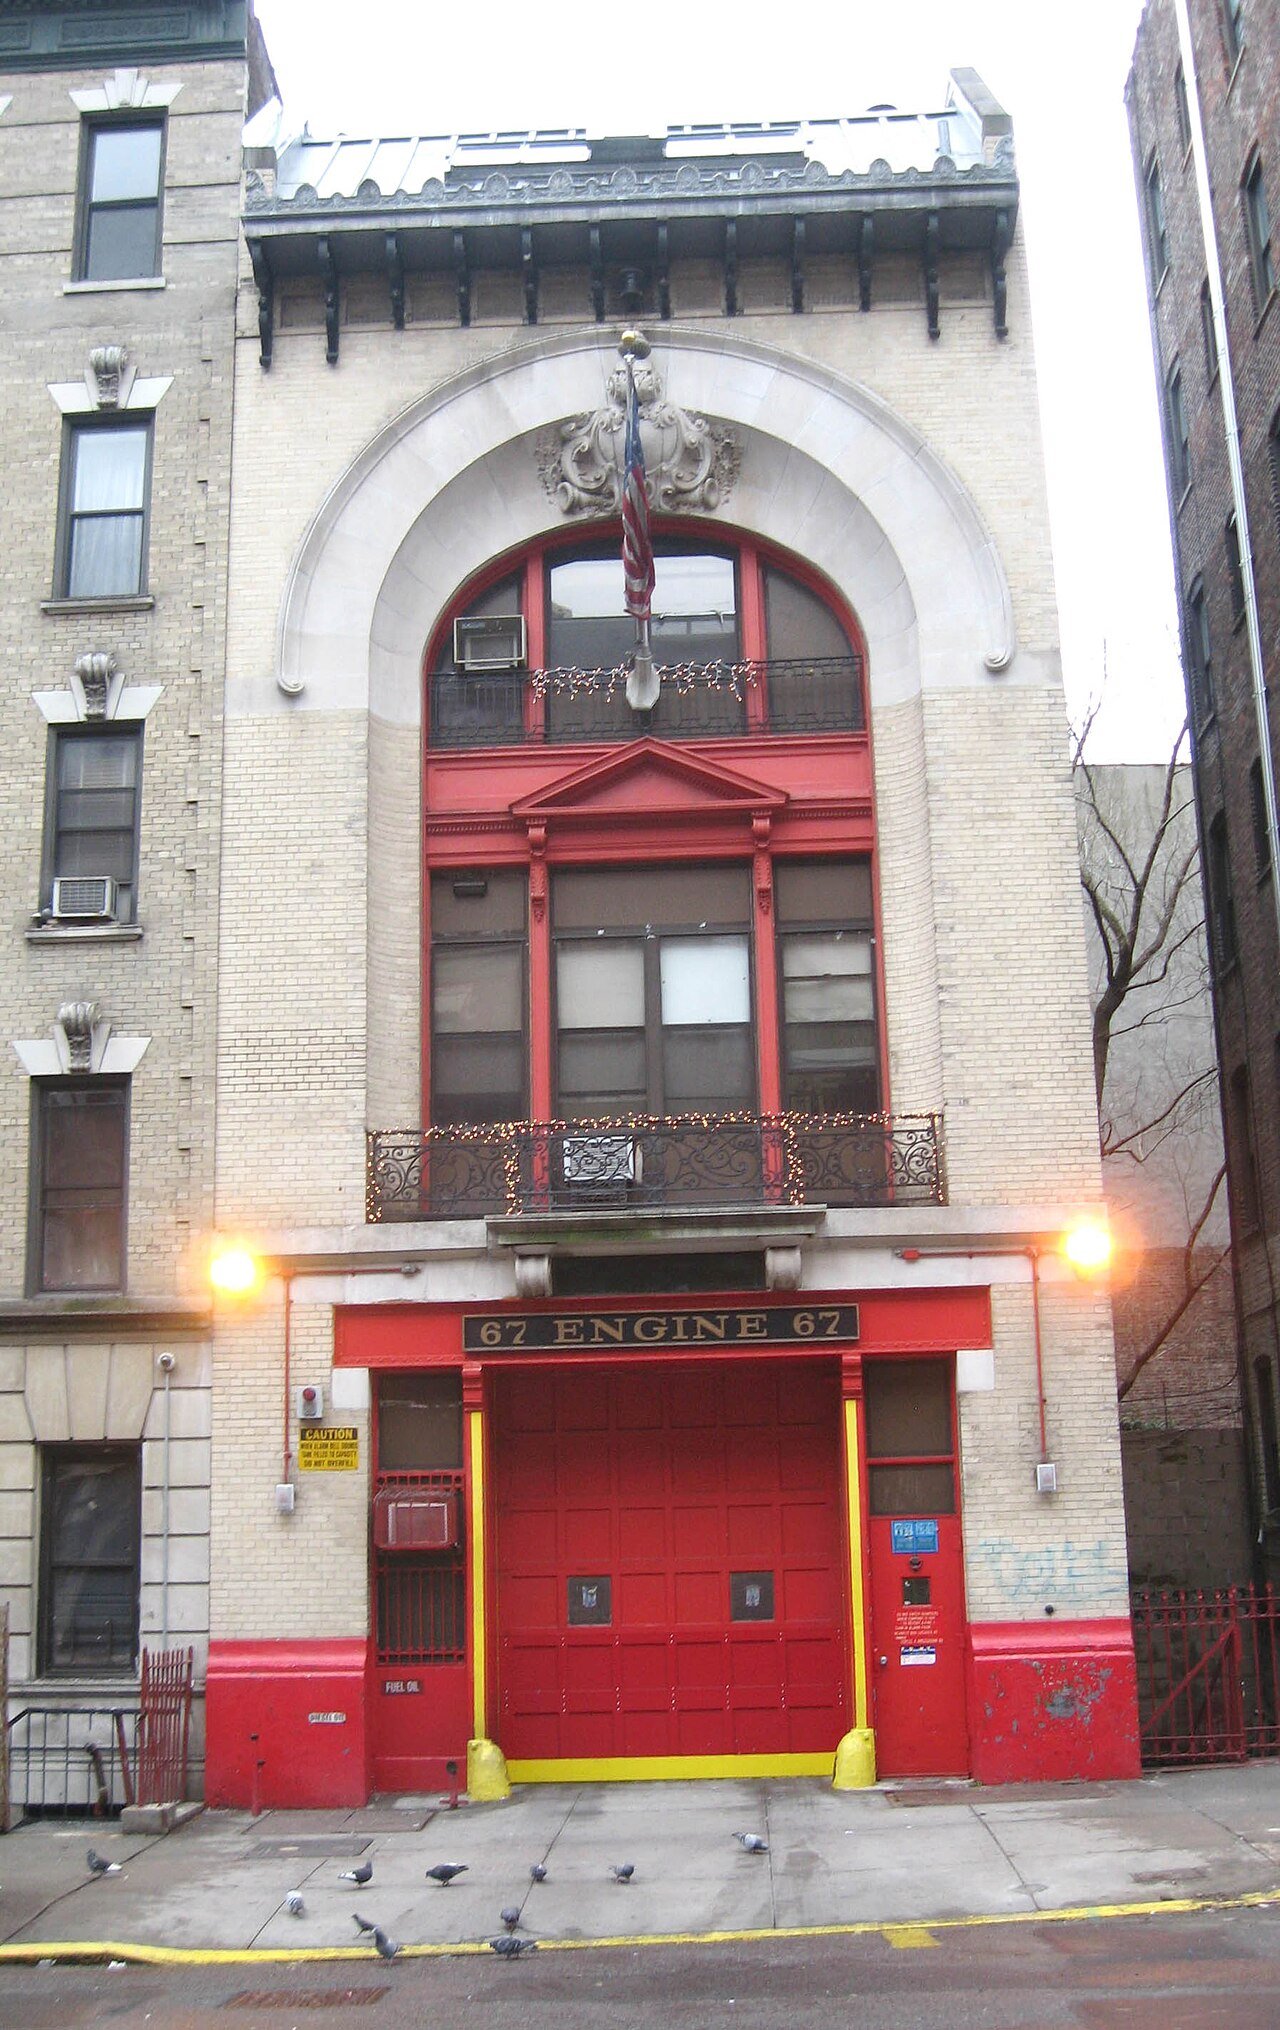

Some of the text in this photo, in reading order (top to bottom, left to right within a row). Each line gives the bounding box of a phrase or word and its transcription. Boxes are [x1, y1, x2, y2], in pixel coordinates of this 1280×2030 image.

[480, 1311, 841, 1346] 67 ENGINE 67
[306, 1429, 354, 1440] CAUTION
[385, 1680, 420, 1694] FUEL OIL
